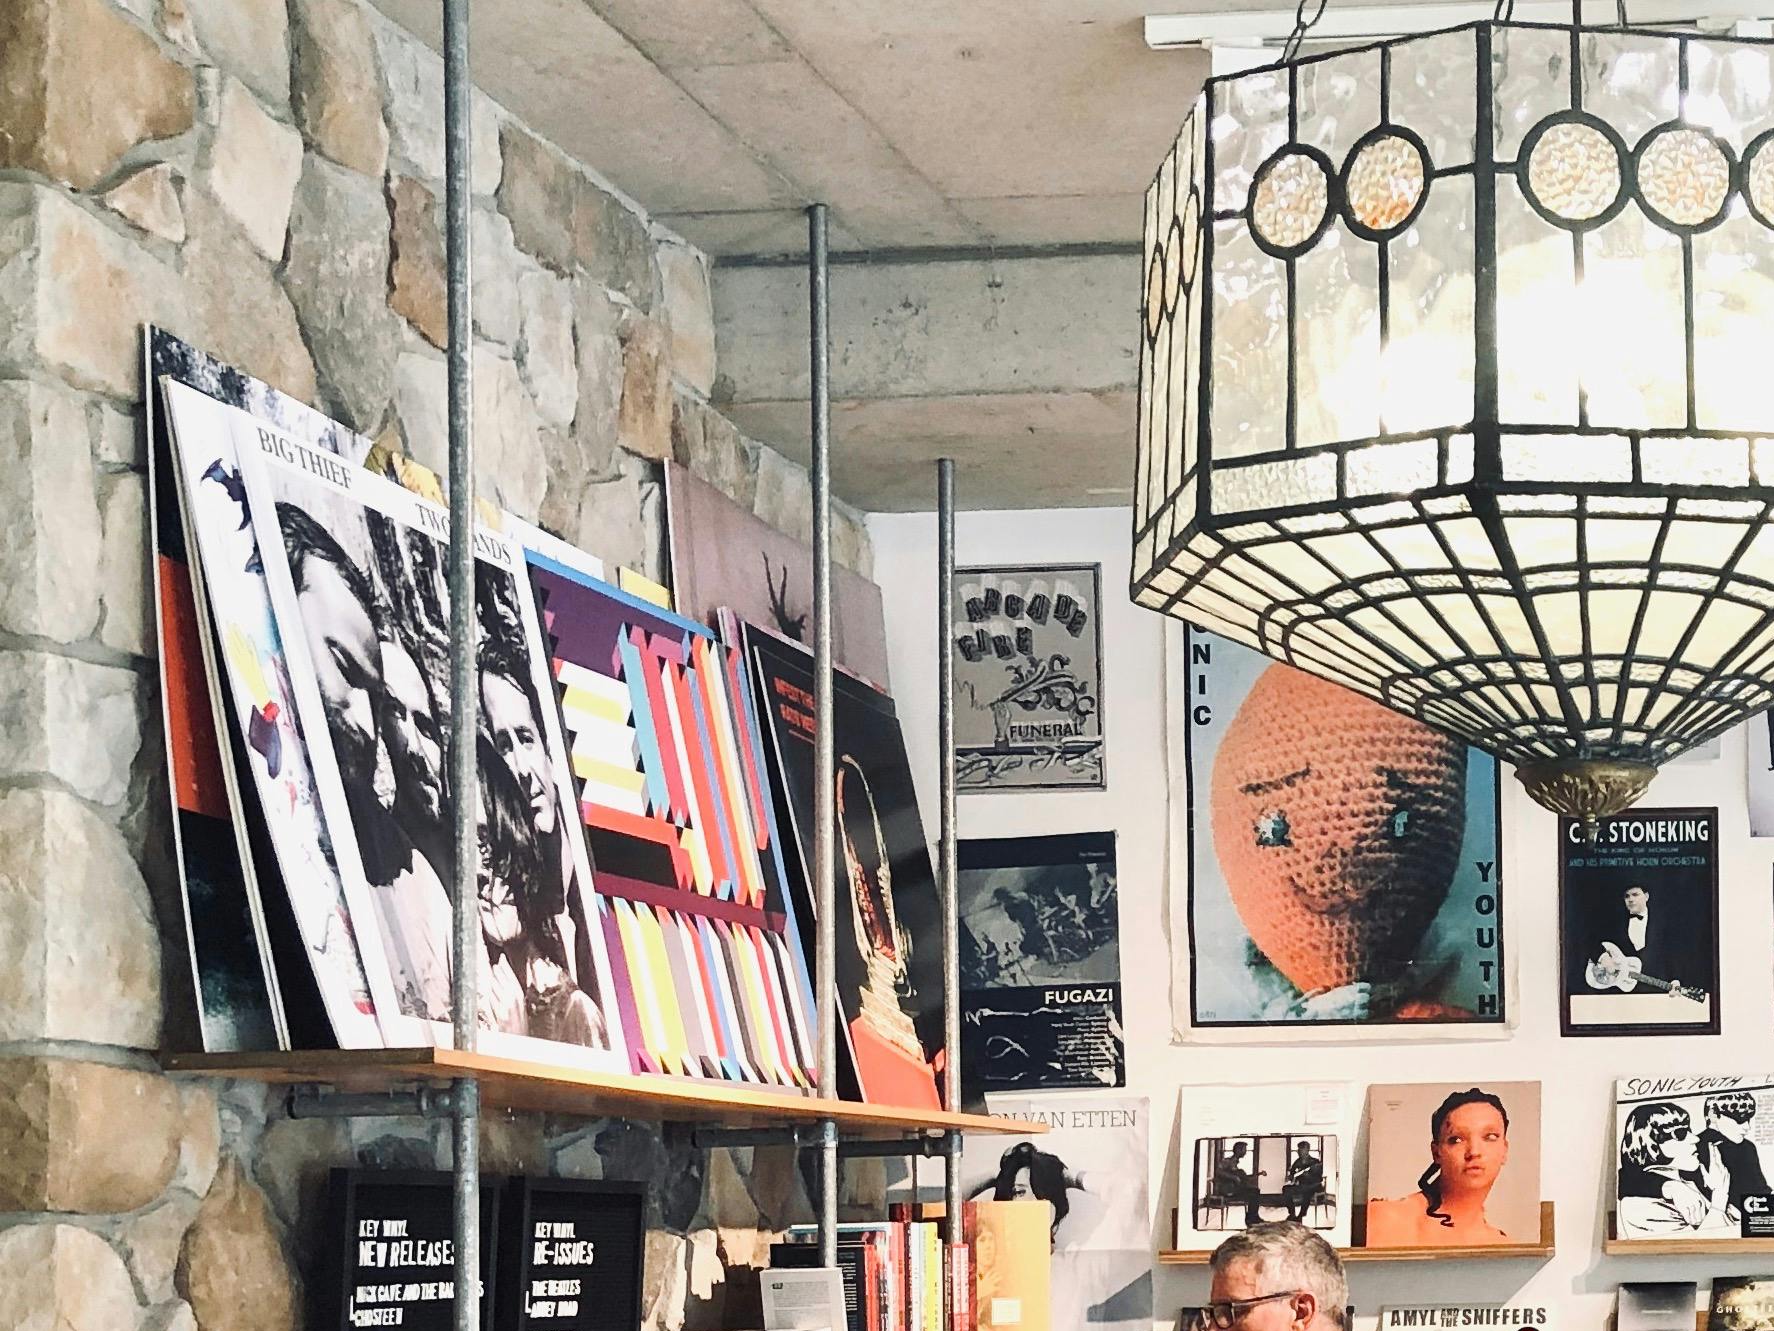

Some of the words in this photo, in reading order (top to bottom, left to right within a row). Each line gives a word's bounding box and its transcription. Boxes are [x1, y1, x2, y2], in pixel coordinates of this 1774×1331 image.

[257, 427, 294, 470] BIG
[297, 446, 351, 489] THIEF
[965, 587, 1088, 639] ARCADE
[957, 625, 1034, 662] FIRE
[1009, 722, 1083, 739] FUNERAL
[1608, 820, 1709, 843] STONEKING
[1475, 861, 1497, 1016] YOUTH
[1044, 988, 1114, 1005] FUGAZI
[1624, 1077, 1685, 1097] SONIC
[1687, 1075, 1744, 1091] YOUTH
[1072, 1109, 1137, 1129] ETTEN
[358, 1220, 380, 1238] KEY
[534, 1222, 553, 1239] KEY
[358, 1241, 388, 1267] NEW
[532, 1240, 595, 1266] RE-ISSUES
[1390, 1309, 1437, 1327] AMYL
[1440, 1316, 1458, 1328] THE
[1441, 1307, 1460, 1318] AND
[1461, 1307, 1548, 1326] SNIFFERS
